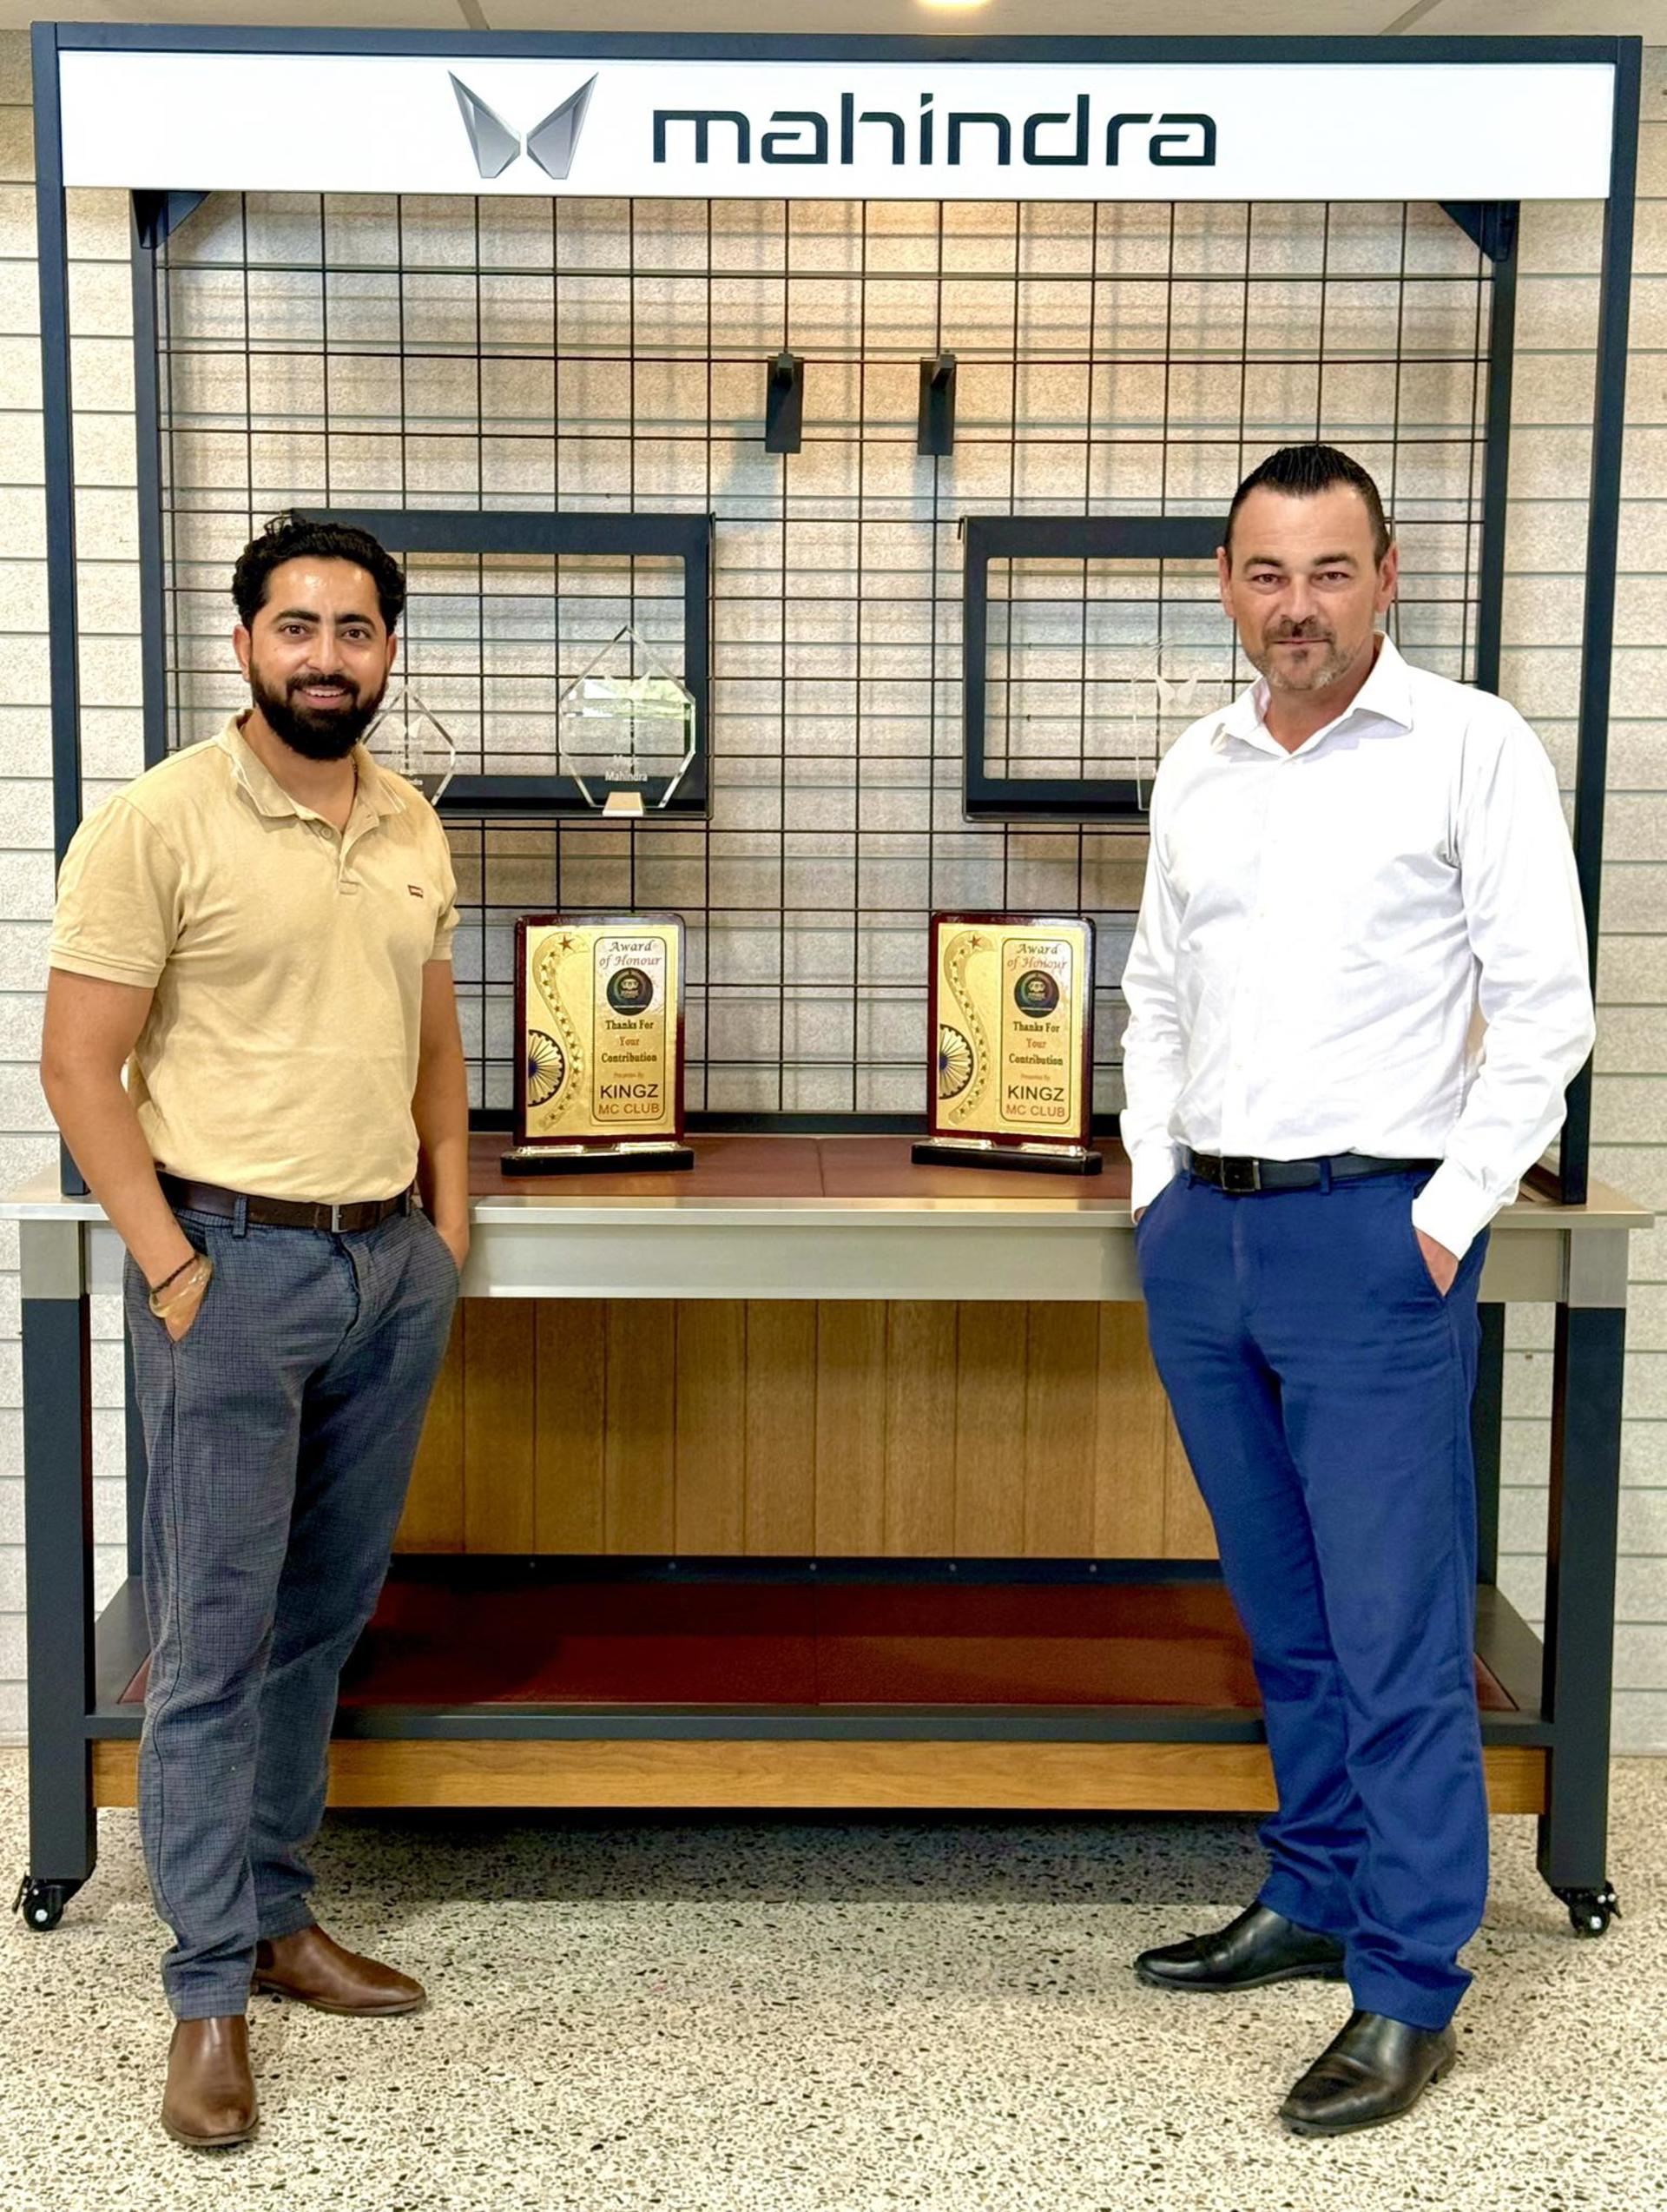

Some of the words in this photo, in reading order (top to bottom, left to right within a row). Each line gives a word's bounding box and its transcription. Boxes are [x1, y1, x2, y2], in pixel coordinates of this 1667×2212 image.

[653, 92, 1216, 166] mahindra
[609, 939, 655, 952] Award
[1017, 943, 1060, 954] Award
[599, 954, 613, 969] of
[614, 954, 662, 966] Honour
[1007, 956, 1020, 971] of
[1022, 956, 1067, 969] Honour
[605, 1019, 637, 1030] Thanks
[639, 1019, 654, 1029] For
[1013, 1020, 1044, 1032] Thanks
[1045, 1022, 1060, 1033] For
[619, 1036, 640, 1047] Your
[1026, 1038, 1047, 1048] Your
[601, 1051, 657, 1063] Contribution
[1009, 1053, 1064, 1066] Contribution
[600, 1084, 659, 1099] KINGZ
[1008, 1085, 1064, 1102] KINGZ
[598, 1103, 619, 1114] MC
[623, 1103, 660, 1114] CLUB
[1006, 1104, 1026, 1116] MC
[1030, 1105, 1065, 1118] CLUB
